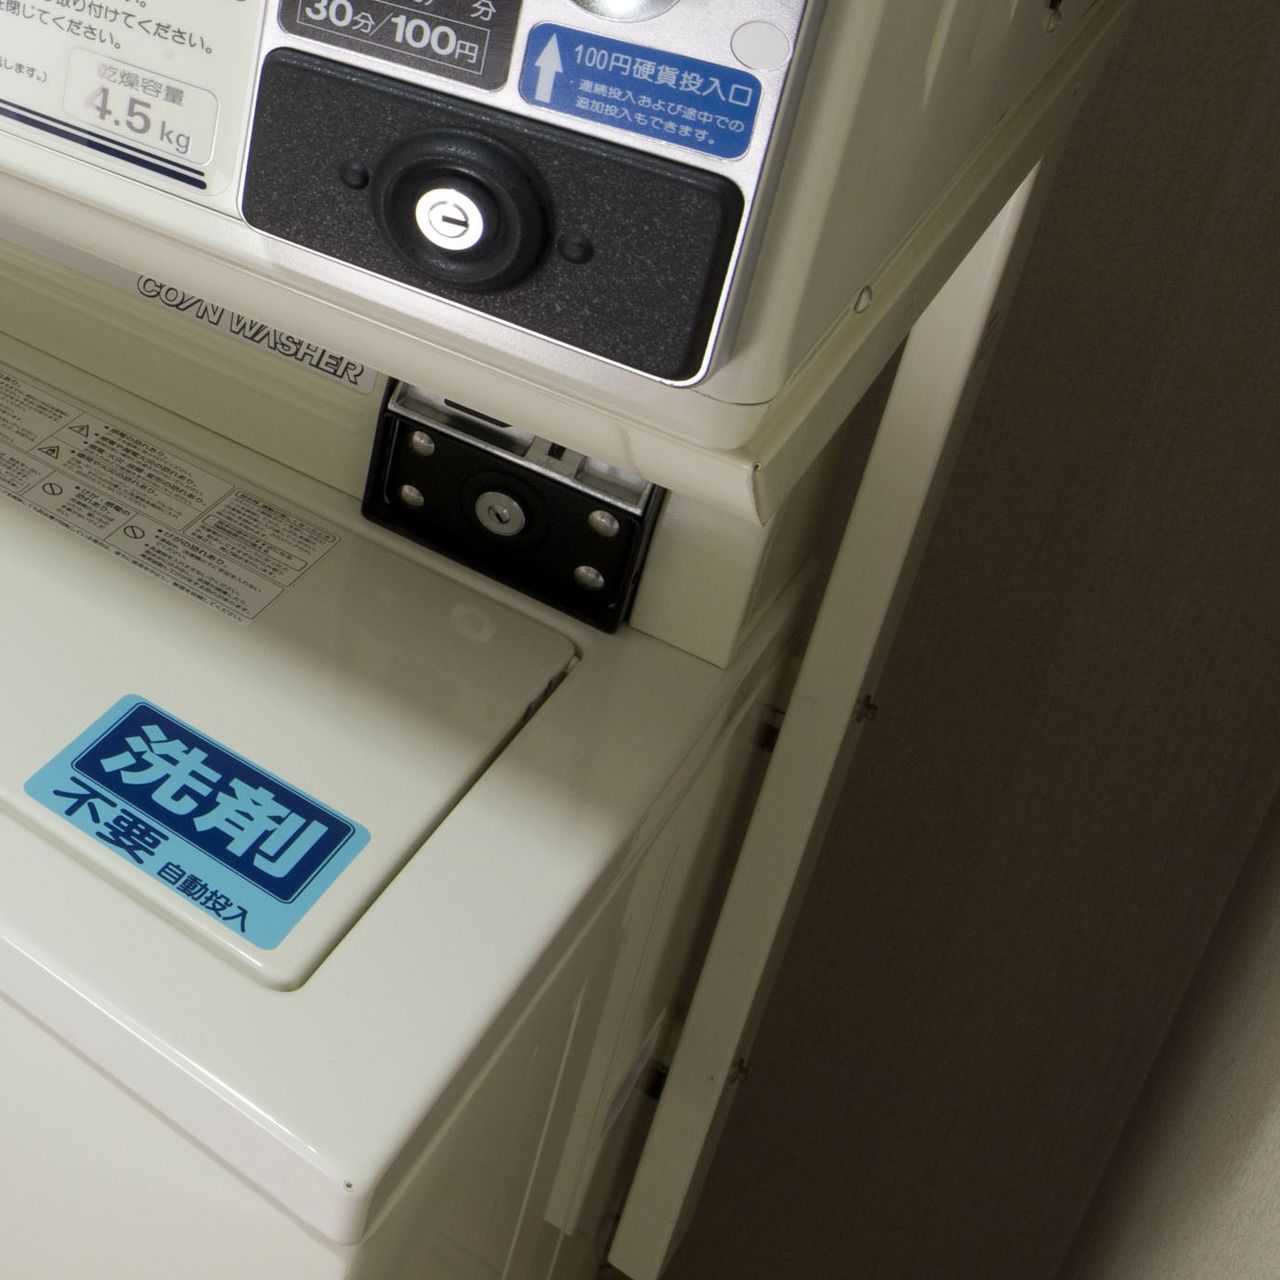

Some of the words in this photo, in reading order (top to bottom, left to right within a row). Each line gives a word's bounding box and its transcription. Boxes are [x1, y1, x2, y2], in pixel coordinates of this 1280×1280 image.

[469, 0, 497, 21] 分
[98, 62, 185, 107] 乾燥容量
[574, 44, 753, 108] 100円硬貨投入口
[87, 86, 152, 135] 4.5
[160, 120, 191, 155] kg
[575, 95, 716, 145] 追加投入もできます。
[229, 311, 365, 386] WASHER
[99, 723, 330, 879] 洗剤
[52, 775, 170, 865] 不要
[156, 861, 250, 933] 自動投入
